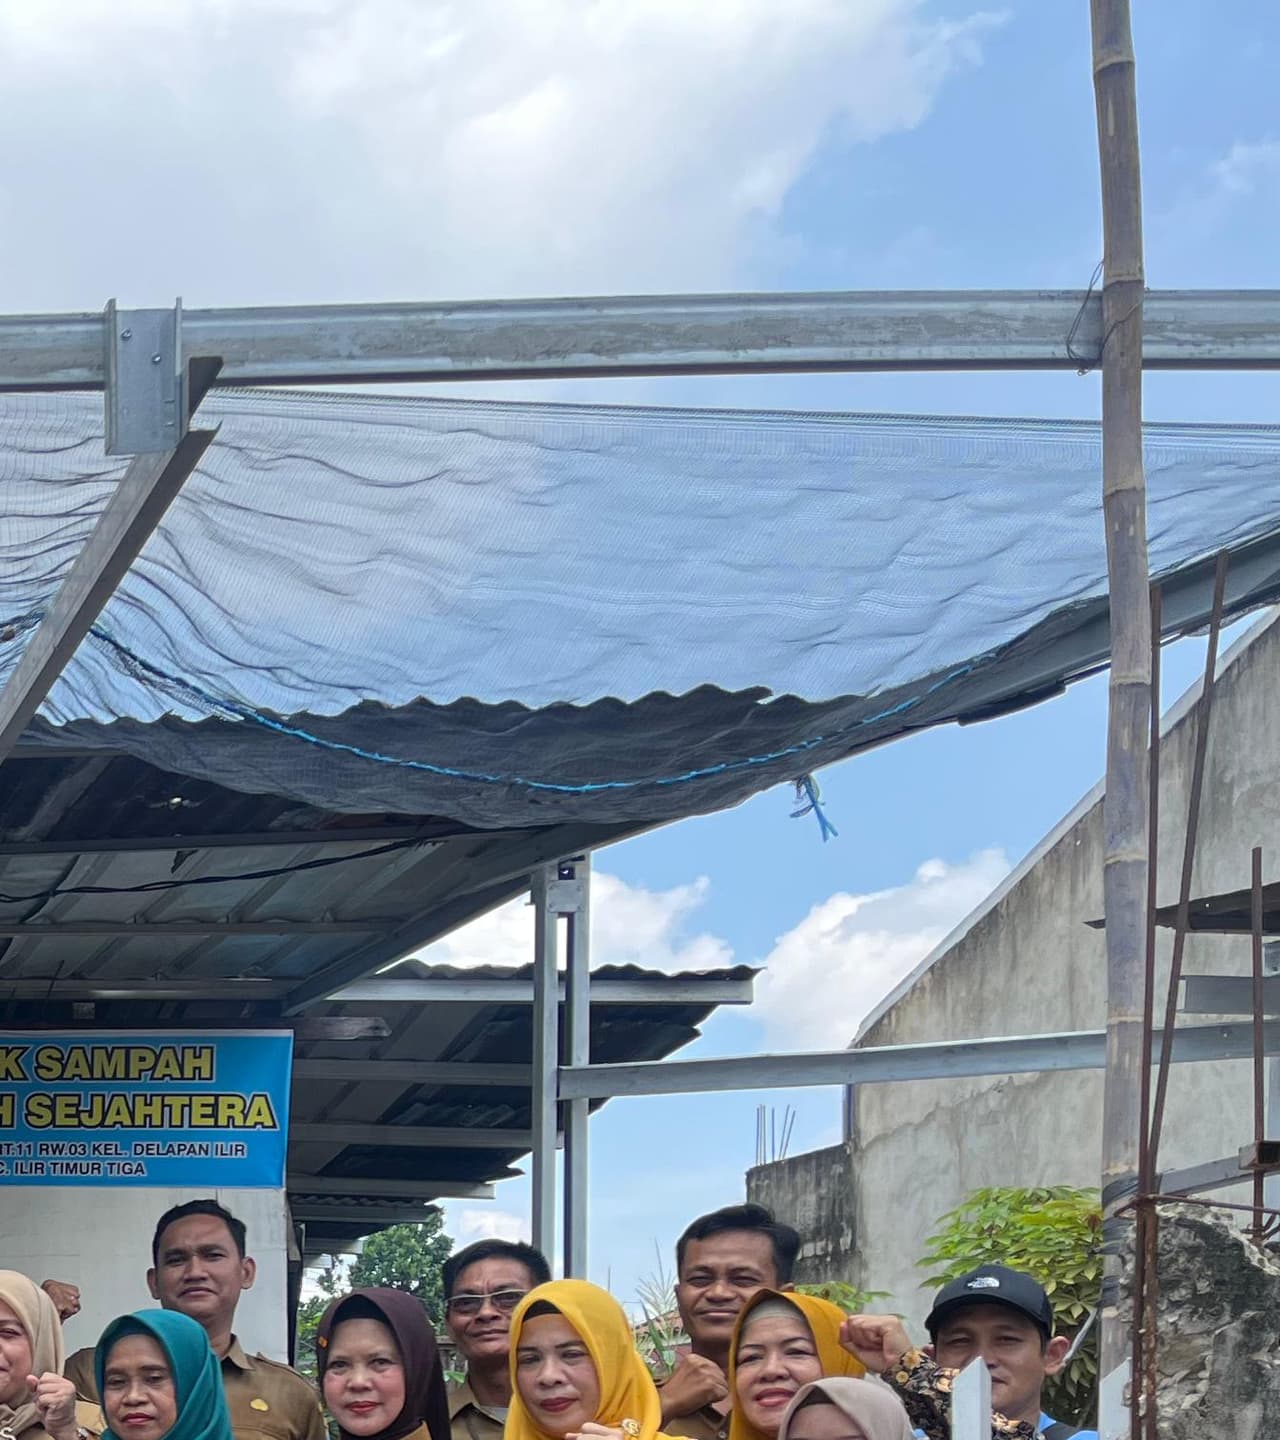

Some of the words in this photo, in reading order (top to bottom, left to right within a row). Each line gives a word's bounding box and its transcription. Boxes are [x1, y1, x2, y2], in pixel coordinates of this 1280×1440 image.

[34, 1046, 215, 1081] SAMPAH
[24, 1093, 278, 1129] SEJAHTERA
[39, 1142, 86, 1156] RW.03
[92, 1142, 127, 1156] KEL.
[133, 1142, 209, 1156] DELAPAN
[215, 1142, 245, 1156] ILIR
[15, 1161, 44, 1175] ILIR
[50, 1161, 102, 1175] TIMUR
[107, 1161, 145, 1175] TIGA
